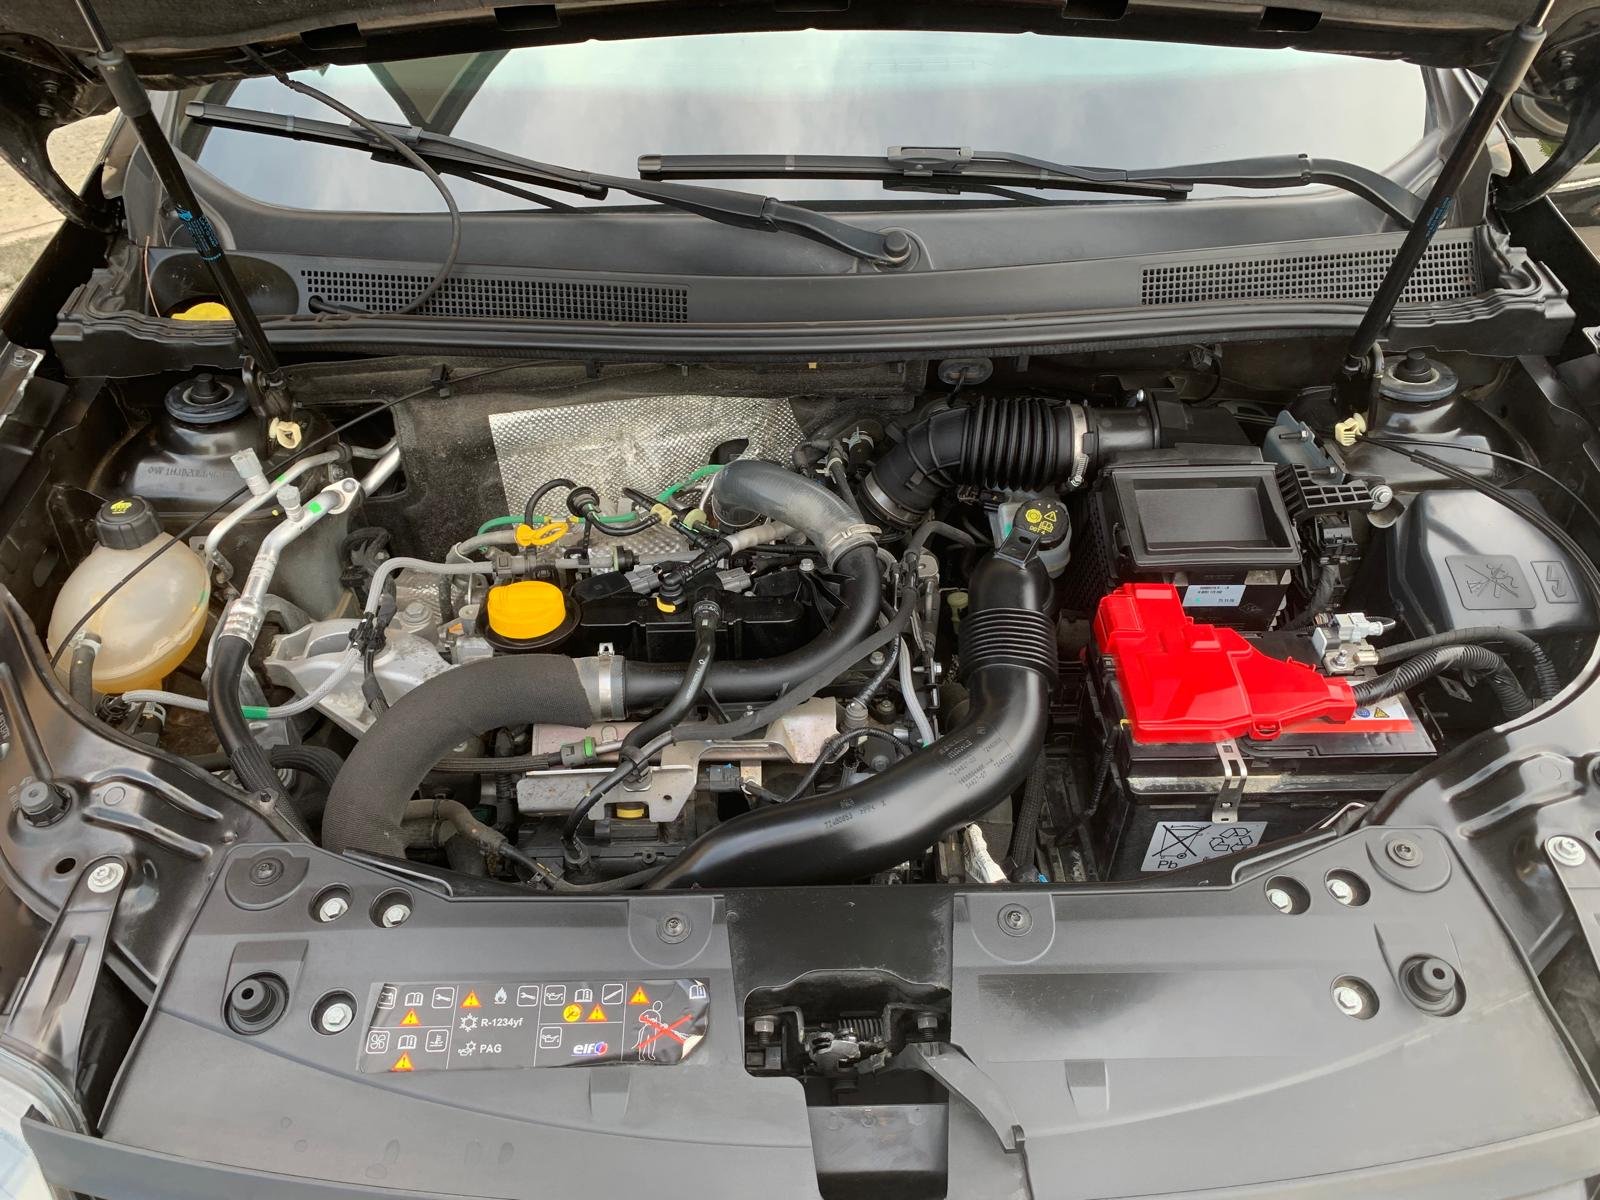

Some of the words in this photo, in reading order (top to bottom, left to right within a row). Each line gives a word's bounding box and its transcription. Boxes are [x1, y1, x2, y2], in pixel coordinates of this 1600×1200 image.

[1157, 860, 1178, 869] Pb
[480, 1017, 524, 1030] R-1234yf
[479, 1043, 502, 1054] PAG
[573, 1042, 597, 1055] elf
